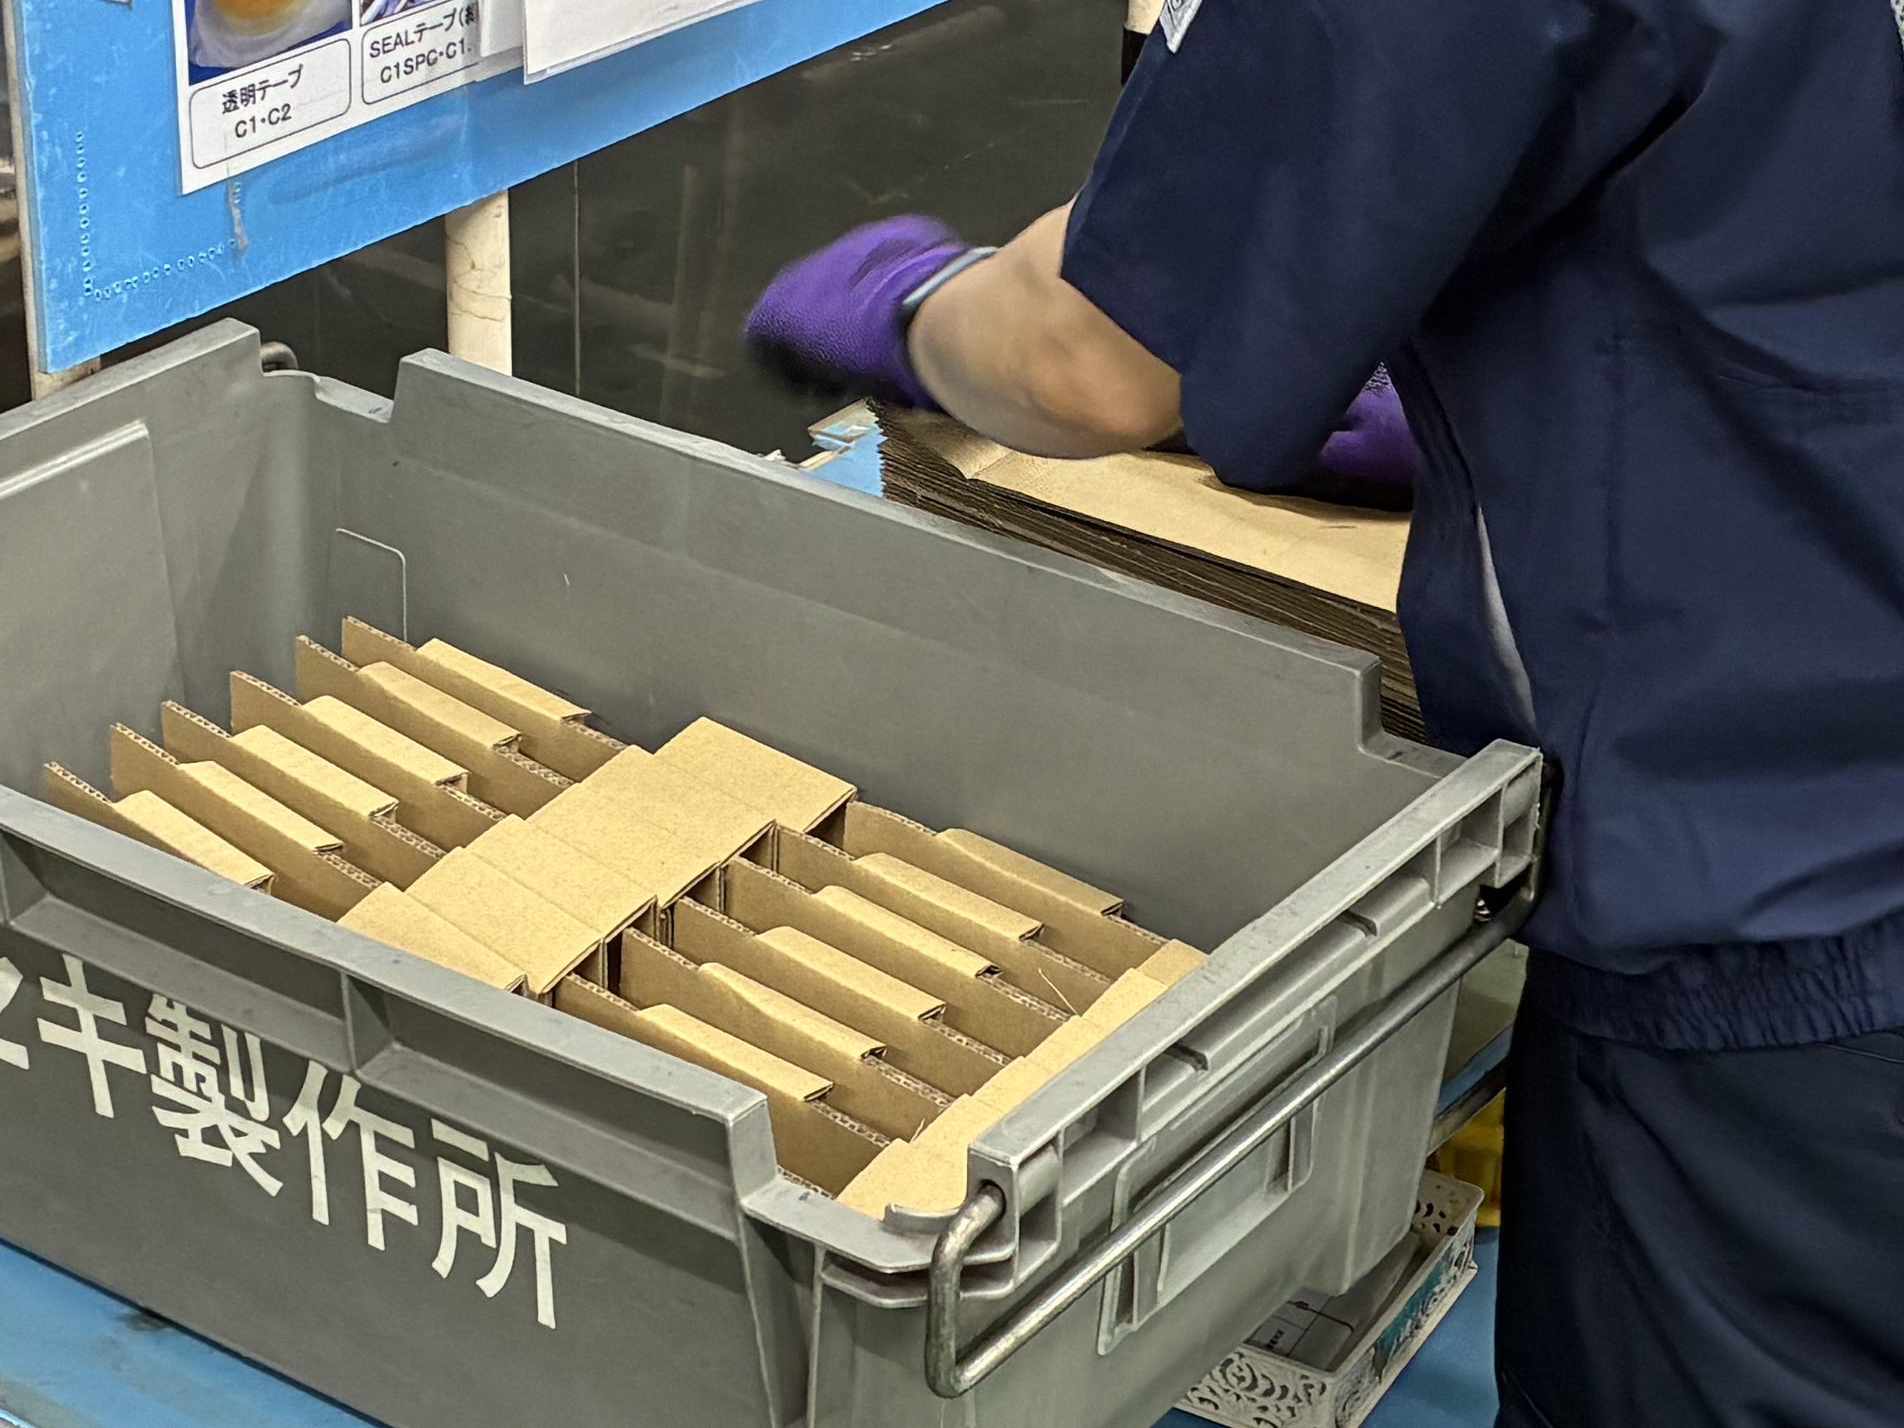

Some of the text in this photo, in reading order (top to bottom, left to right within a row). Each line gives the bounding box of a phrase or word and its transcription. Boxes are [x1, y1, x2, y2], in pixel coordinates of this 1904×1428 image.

[221, 64, 304, 116] 透明テープ
